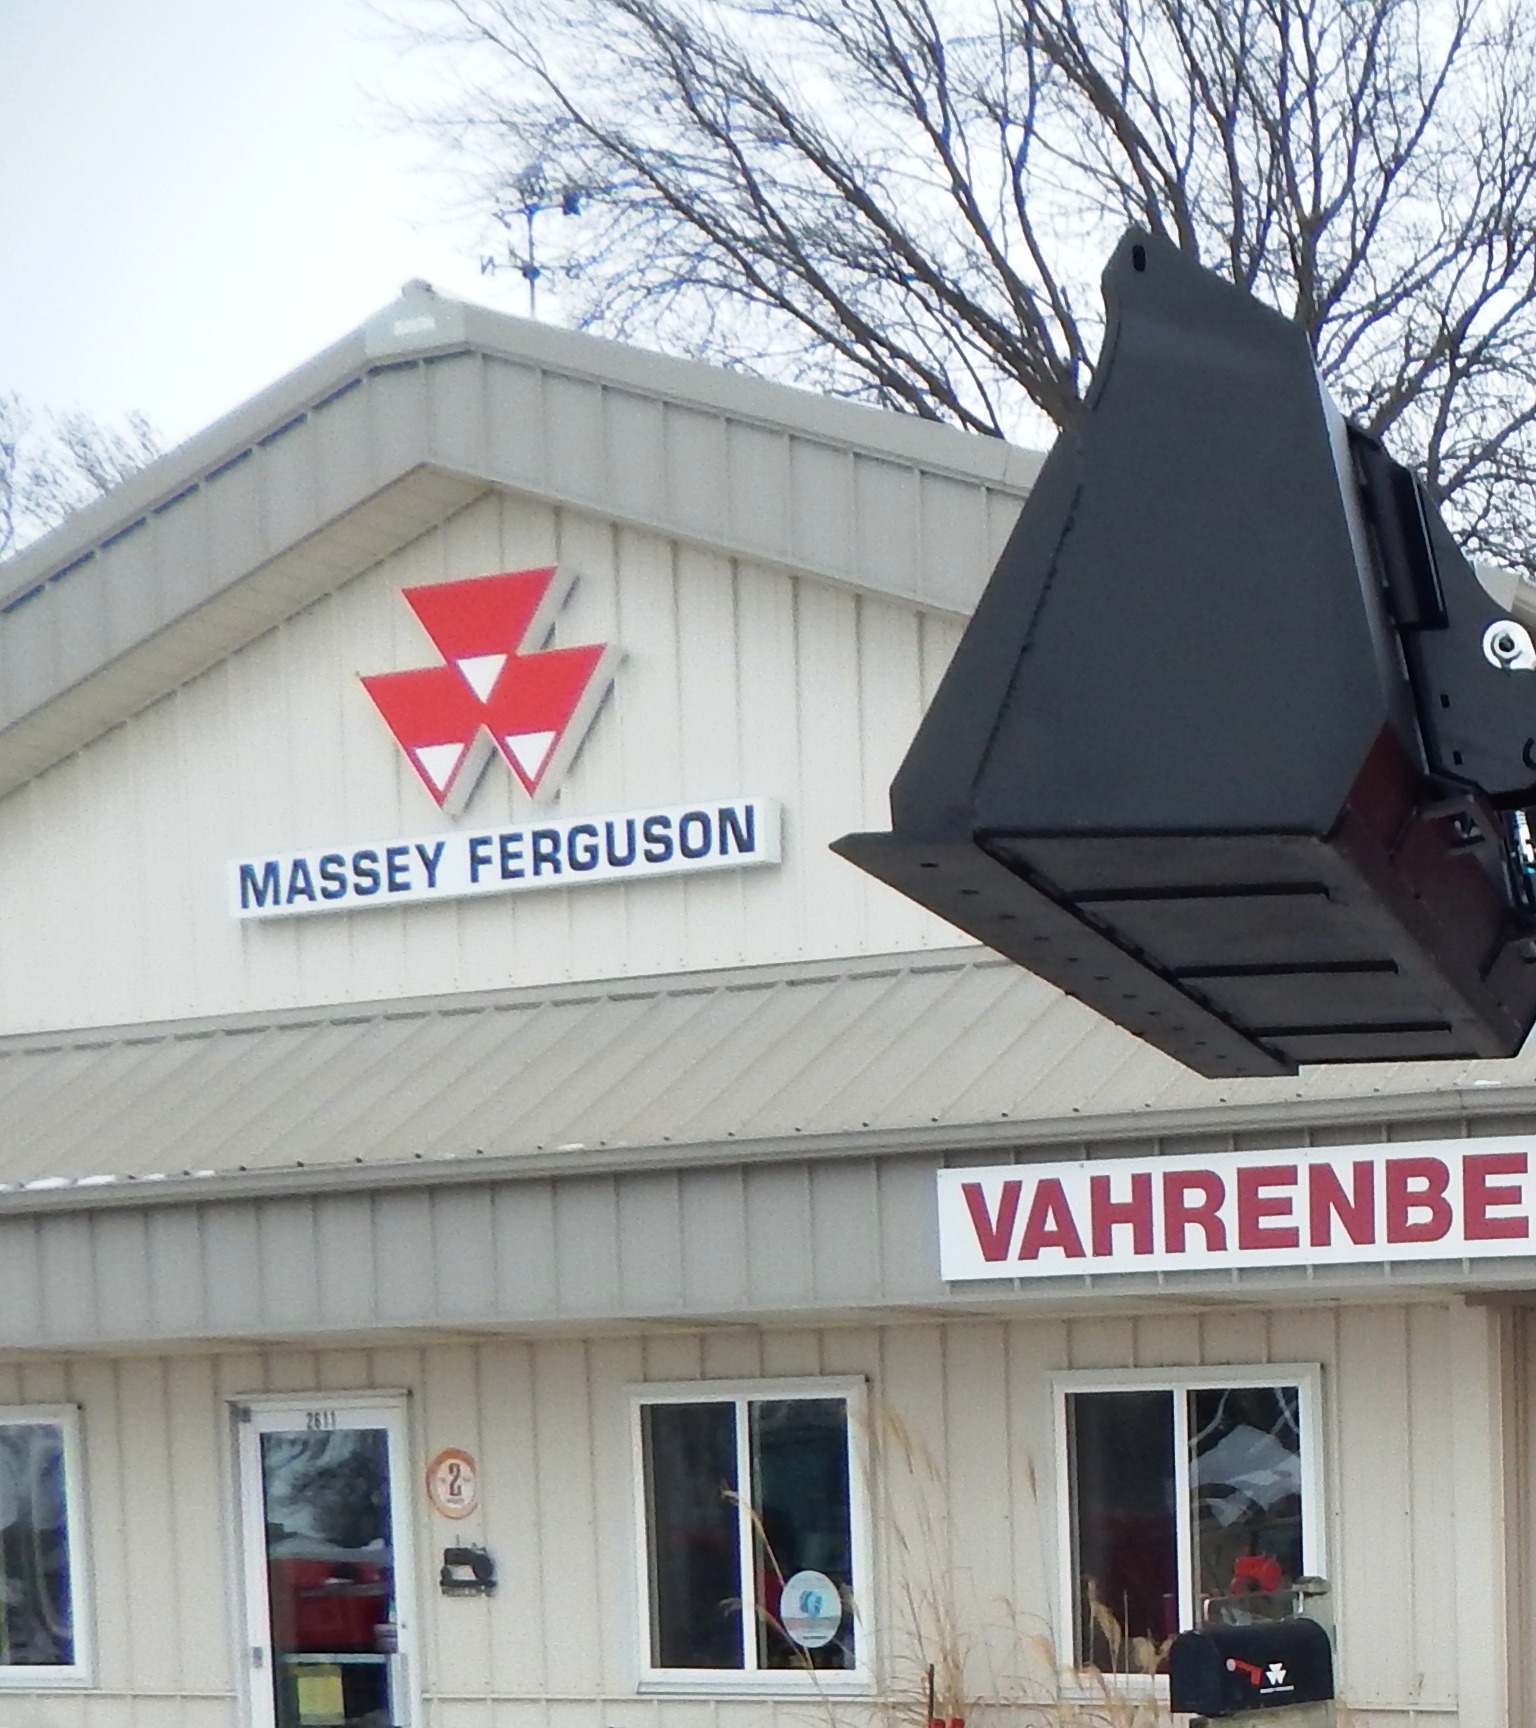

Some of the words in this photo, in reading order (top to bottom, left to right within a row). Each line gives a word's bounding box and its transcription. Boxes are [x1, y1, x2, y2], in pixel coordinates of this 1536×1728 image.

[239, 841, 446, 910] MASSEY
[469, 804, 757, 883] FERGUSON
[306, 1410, 336, 1430] 2611
[448, 1462, 462, 1497] 2
